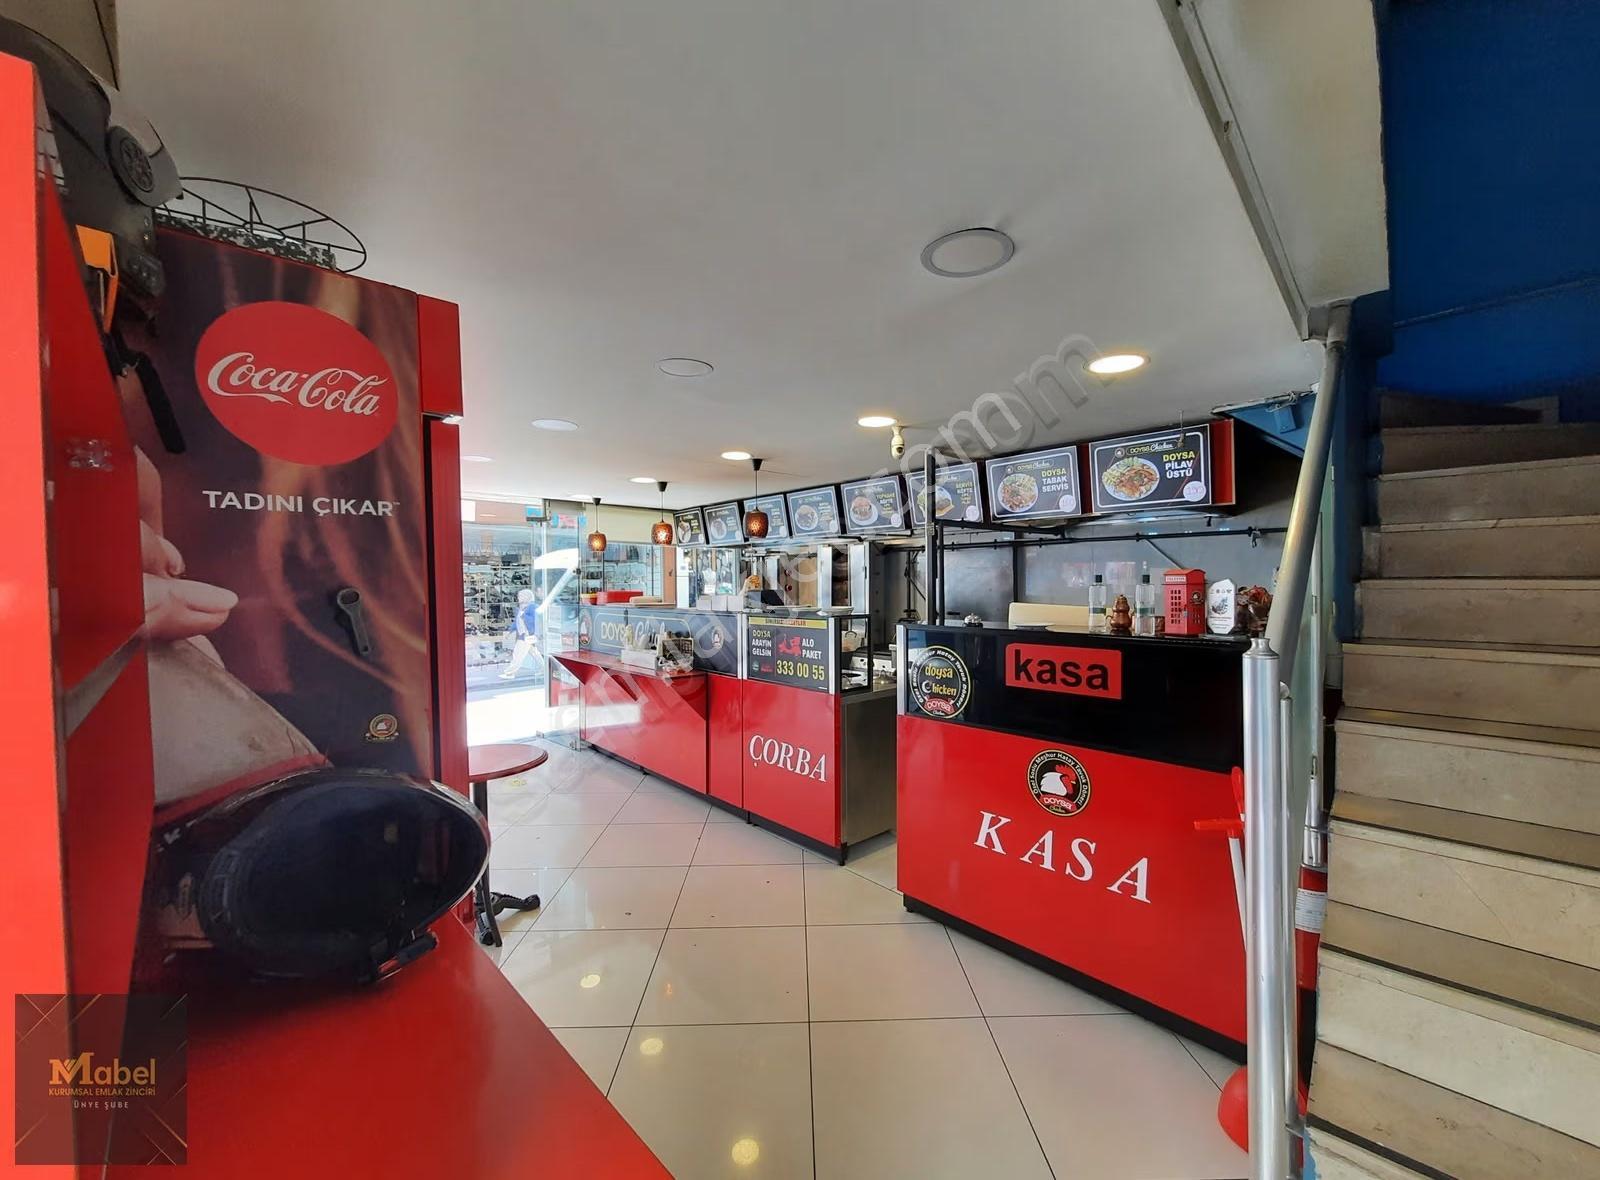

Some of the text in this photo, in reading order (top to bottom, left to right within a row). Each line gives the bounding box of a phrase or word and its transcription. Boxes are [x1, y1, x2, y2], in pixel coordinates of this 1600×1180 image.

[208, 352, 388, 416] Coca-Cola
[1163, 451, 1195, 462] DOYSA
[1165, 460, 1193, 470] PİLAV
[1041, 468, 1067, 477] DOYSA
[1166, 468, 1193, 479] ÜSTÜ
[1042, 476, 1068, 485] TABAK
[1042, 483, 1069, 493] SERVİS
[202, 490, 303, 513] TADINI
[752, 629, 771, 638] DOYSA
[752, 638, 772, 648] ARAYIN
[802, 638, 815, 648] ALO
[802, 649, 822, 660] PAKET
[776, 660, 794, 676] 333
[797, 662, 809, 678] 00
[812, 664, 825, 681] 55
[924, 663, 953, 680] doysa
[936, 650, 956, 662] Hatay
[955, 661, 967, 684] Tavuk
[1014, 649, 1110, 692] kasa
[749, 734, 827, 782] ÇORBA
[1057, 753, 1076, 765] Hatay
[1075, 765, 1087, 783] Tavuk
[974, 810, 1152, 904] KASA
